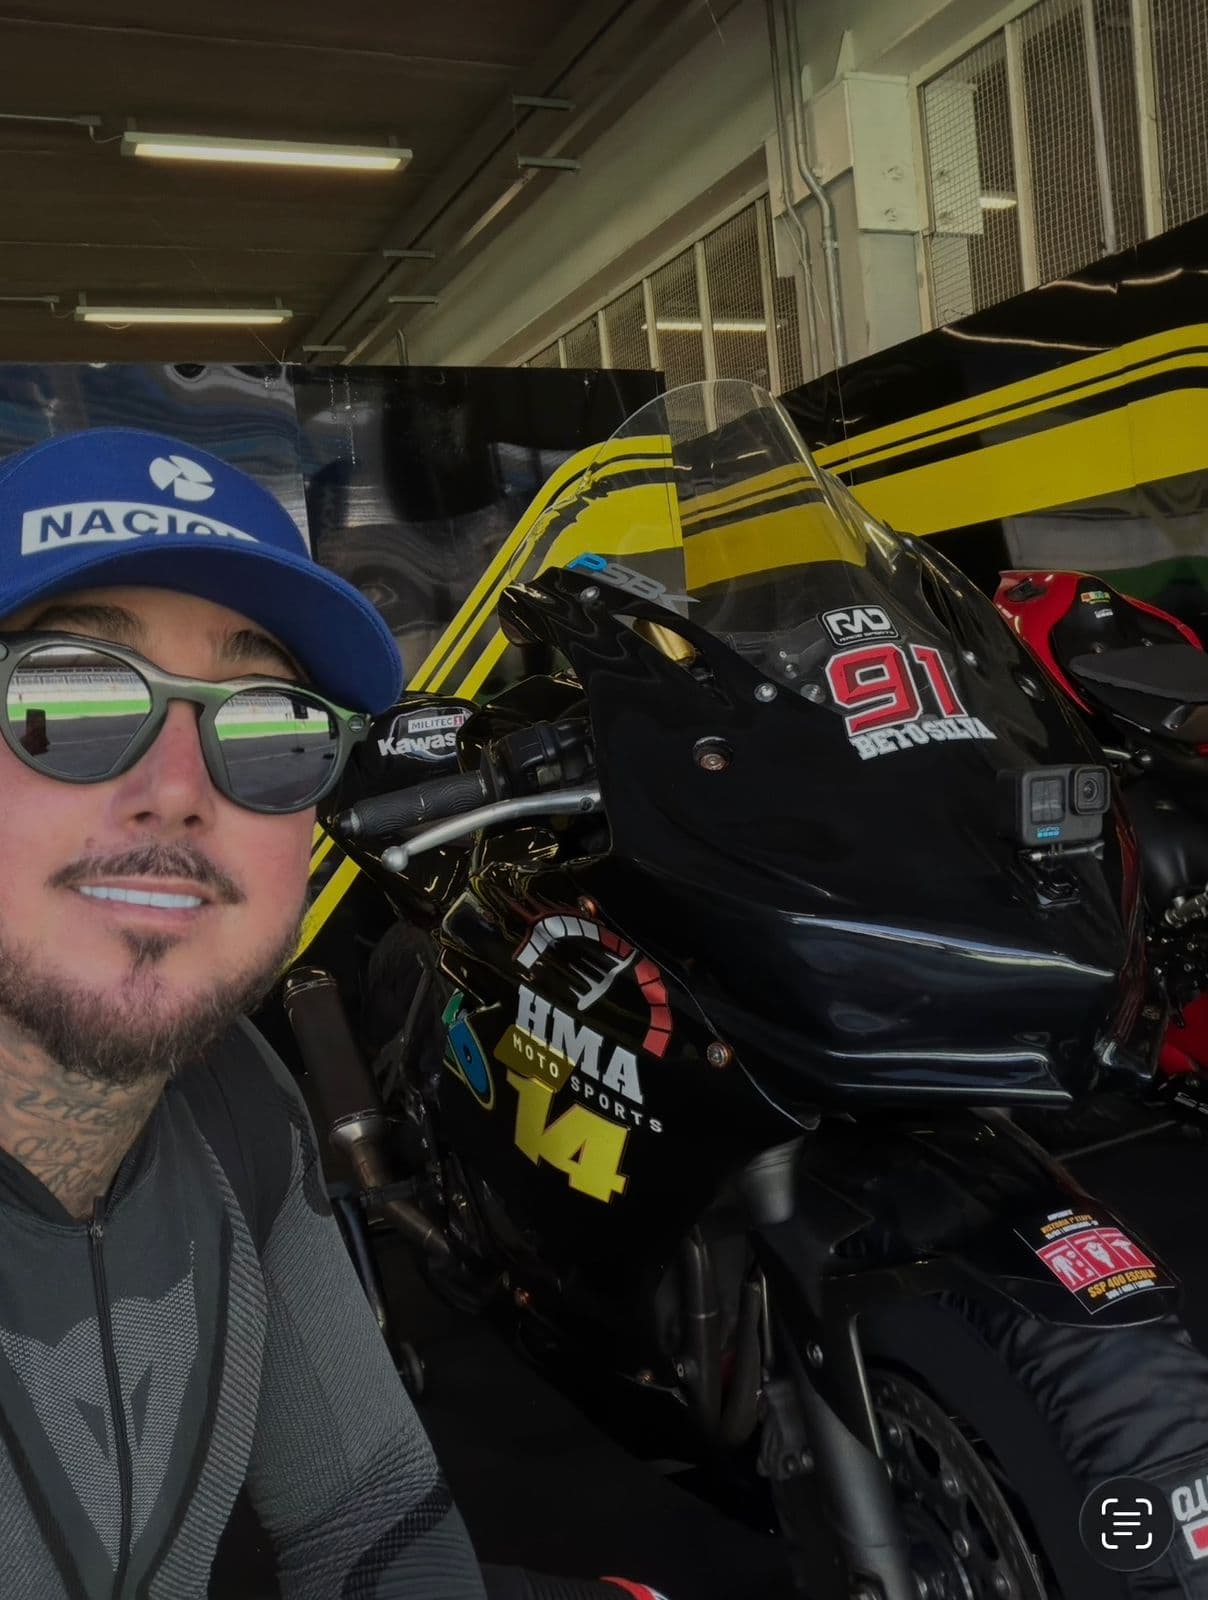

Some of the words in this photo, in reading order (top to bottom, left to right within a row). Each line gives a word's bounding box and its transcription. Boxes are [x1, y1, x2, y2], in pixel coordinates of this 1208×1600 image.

[39, 508, 238, 543] NACIO
[827, 606, 892, 635] RAD
[825, 643, 968, 737] 91
[378, 732, 457, 757] Kawas
[512, 1033, 560, 1079] MOTO
[570, 1076, 663, 1133] SPORTS
[515, 984, 644, 1105] HMA
[505, 1069, 629, 1204] 14
